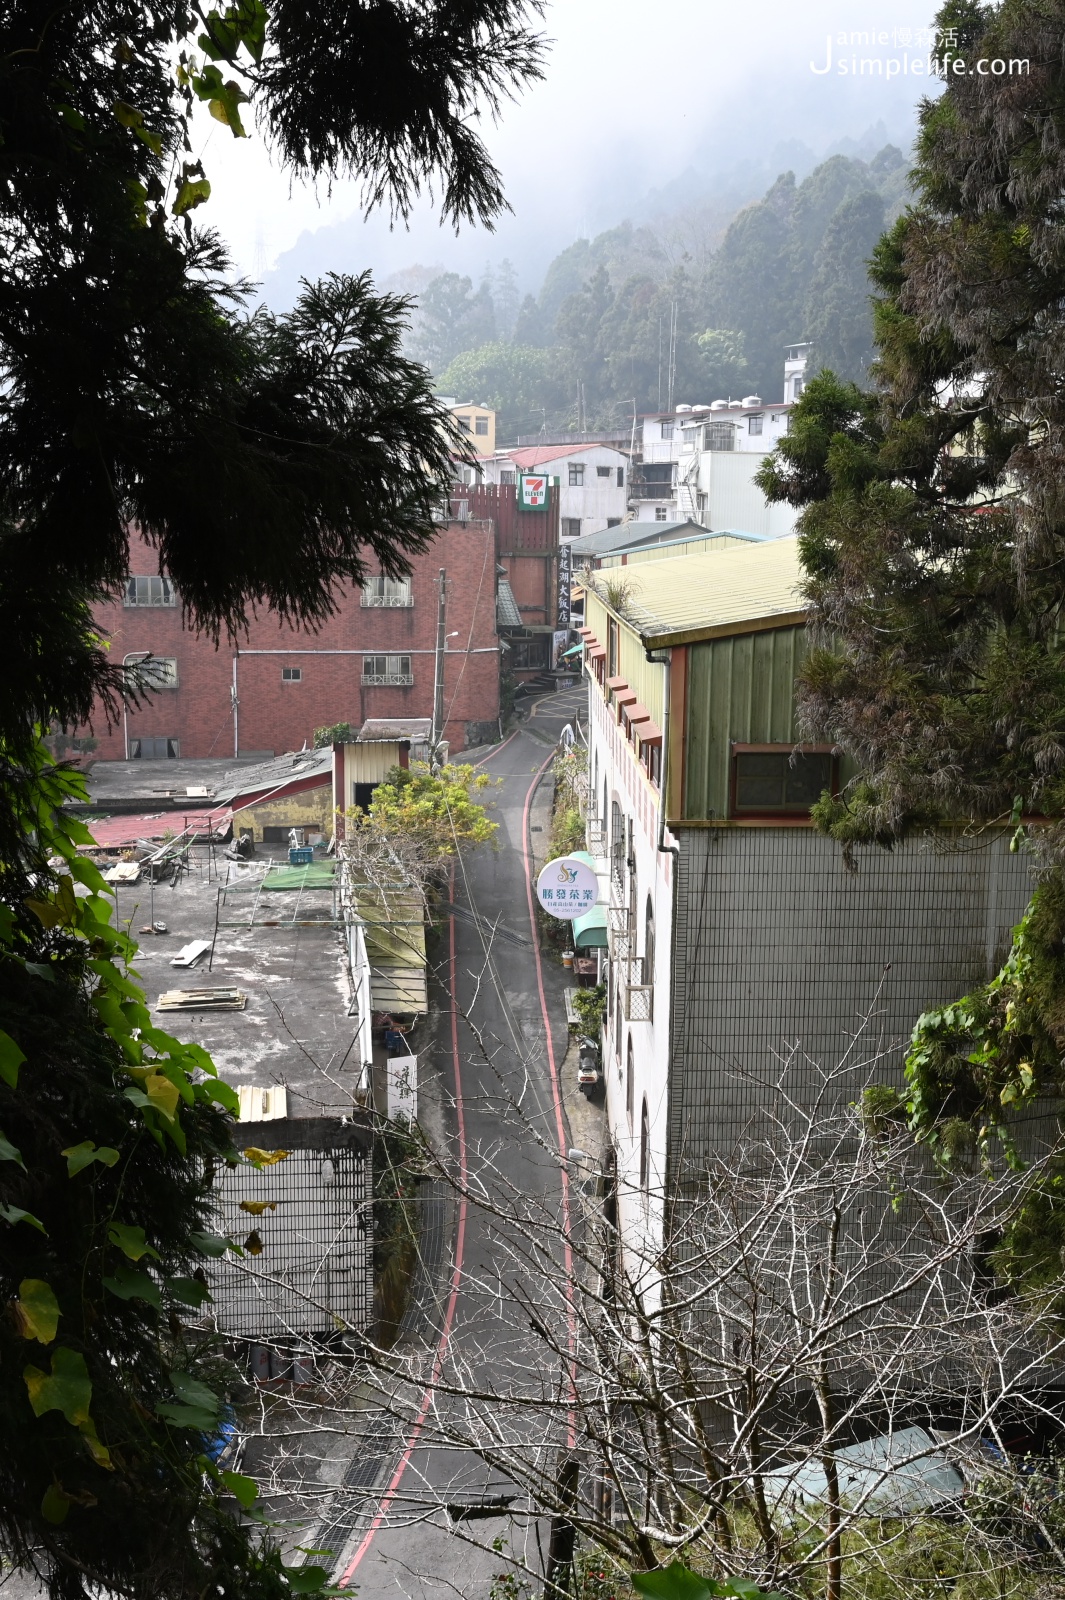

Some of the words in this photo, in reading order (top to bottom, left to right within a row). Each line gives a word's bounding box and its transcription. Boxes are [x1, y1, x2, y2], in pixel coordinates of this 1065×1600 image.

[558, 545, 570, 622] 奮起湖大飯店
[542, 888, 593, 900] 勝發茶業
